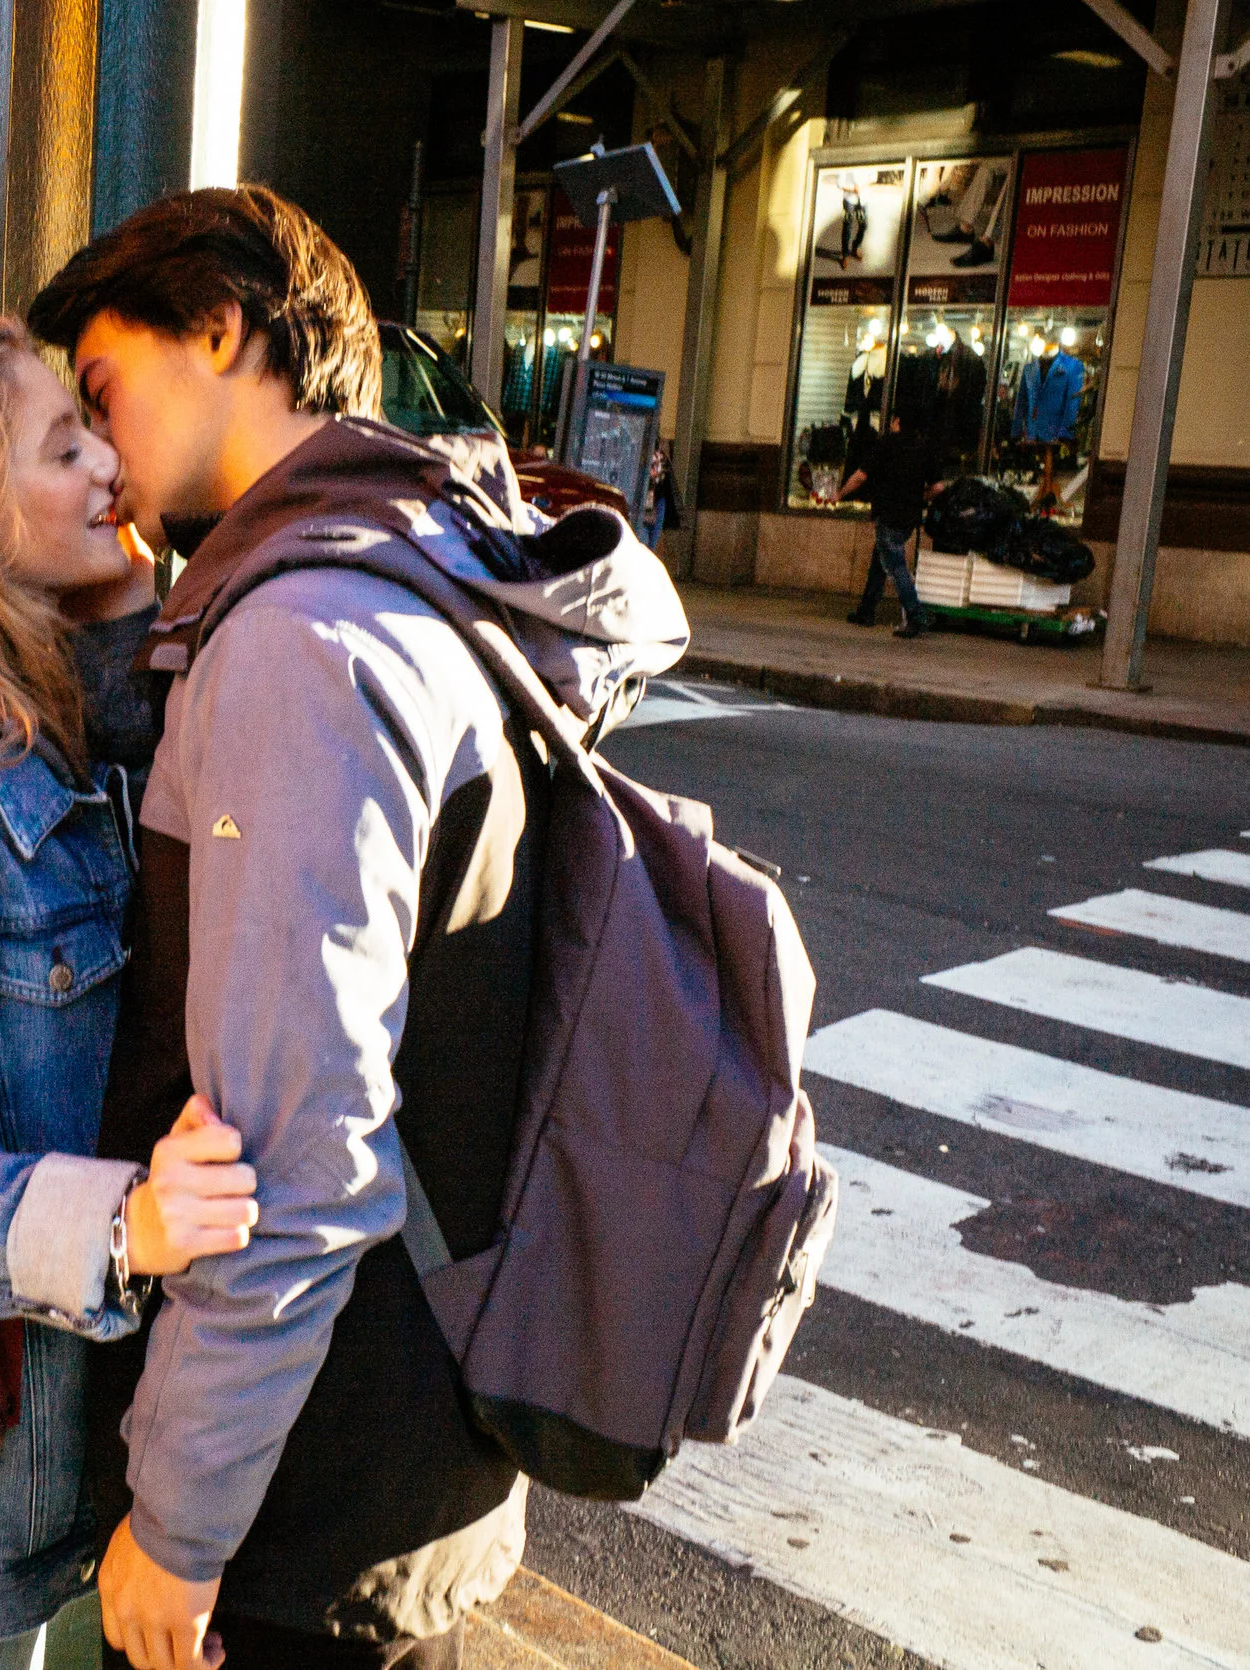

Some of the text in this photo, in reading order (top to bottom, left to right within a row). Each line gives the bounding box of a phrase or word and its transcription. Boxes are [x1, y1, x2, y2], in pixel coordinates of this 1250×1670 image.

[1026, 183, 1119, 205] IMPRESSION
[1027, 222, 1109, 238] ON FASHION
